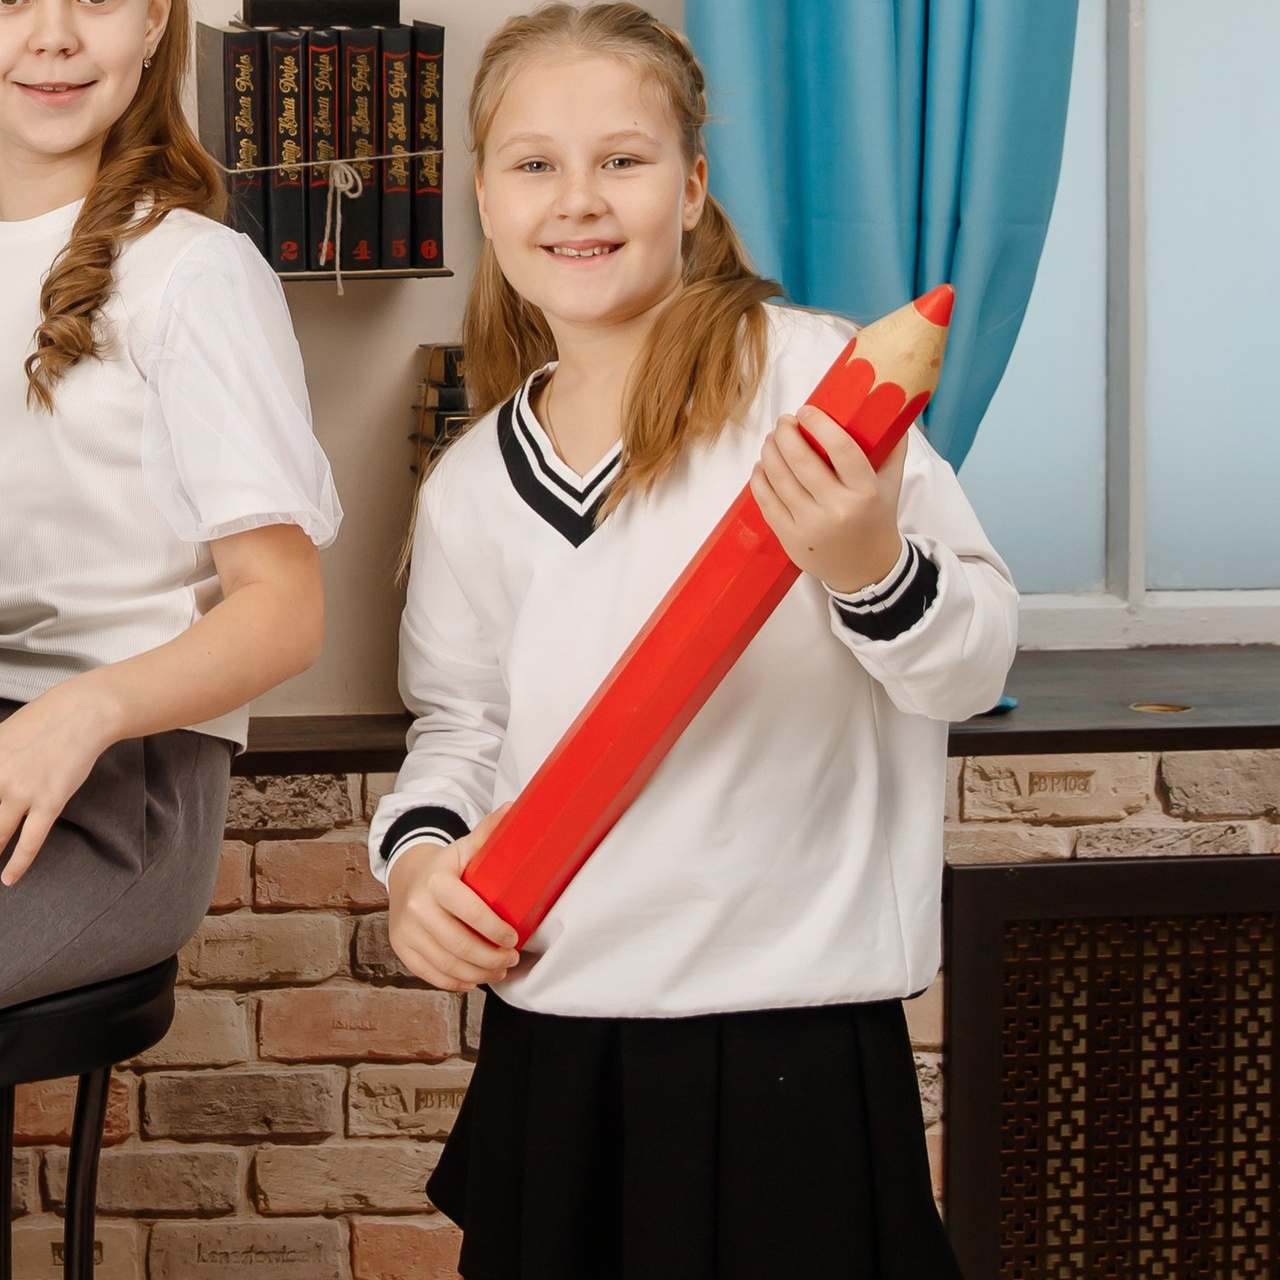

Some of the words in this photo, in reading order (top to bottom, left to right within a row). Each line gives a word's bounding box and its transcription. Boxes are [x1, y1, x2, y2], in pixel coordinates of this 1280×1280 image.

[280, 241, 298, 261] 2
[318, 240, 335, 260] 3
[352, 240, 371, 260] 4
[391, 238, 407, 258] 5
[421, 239, 438, 259] 6
